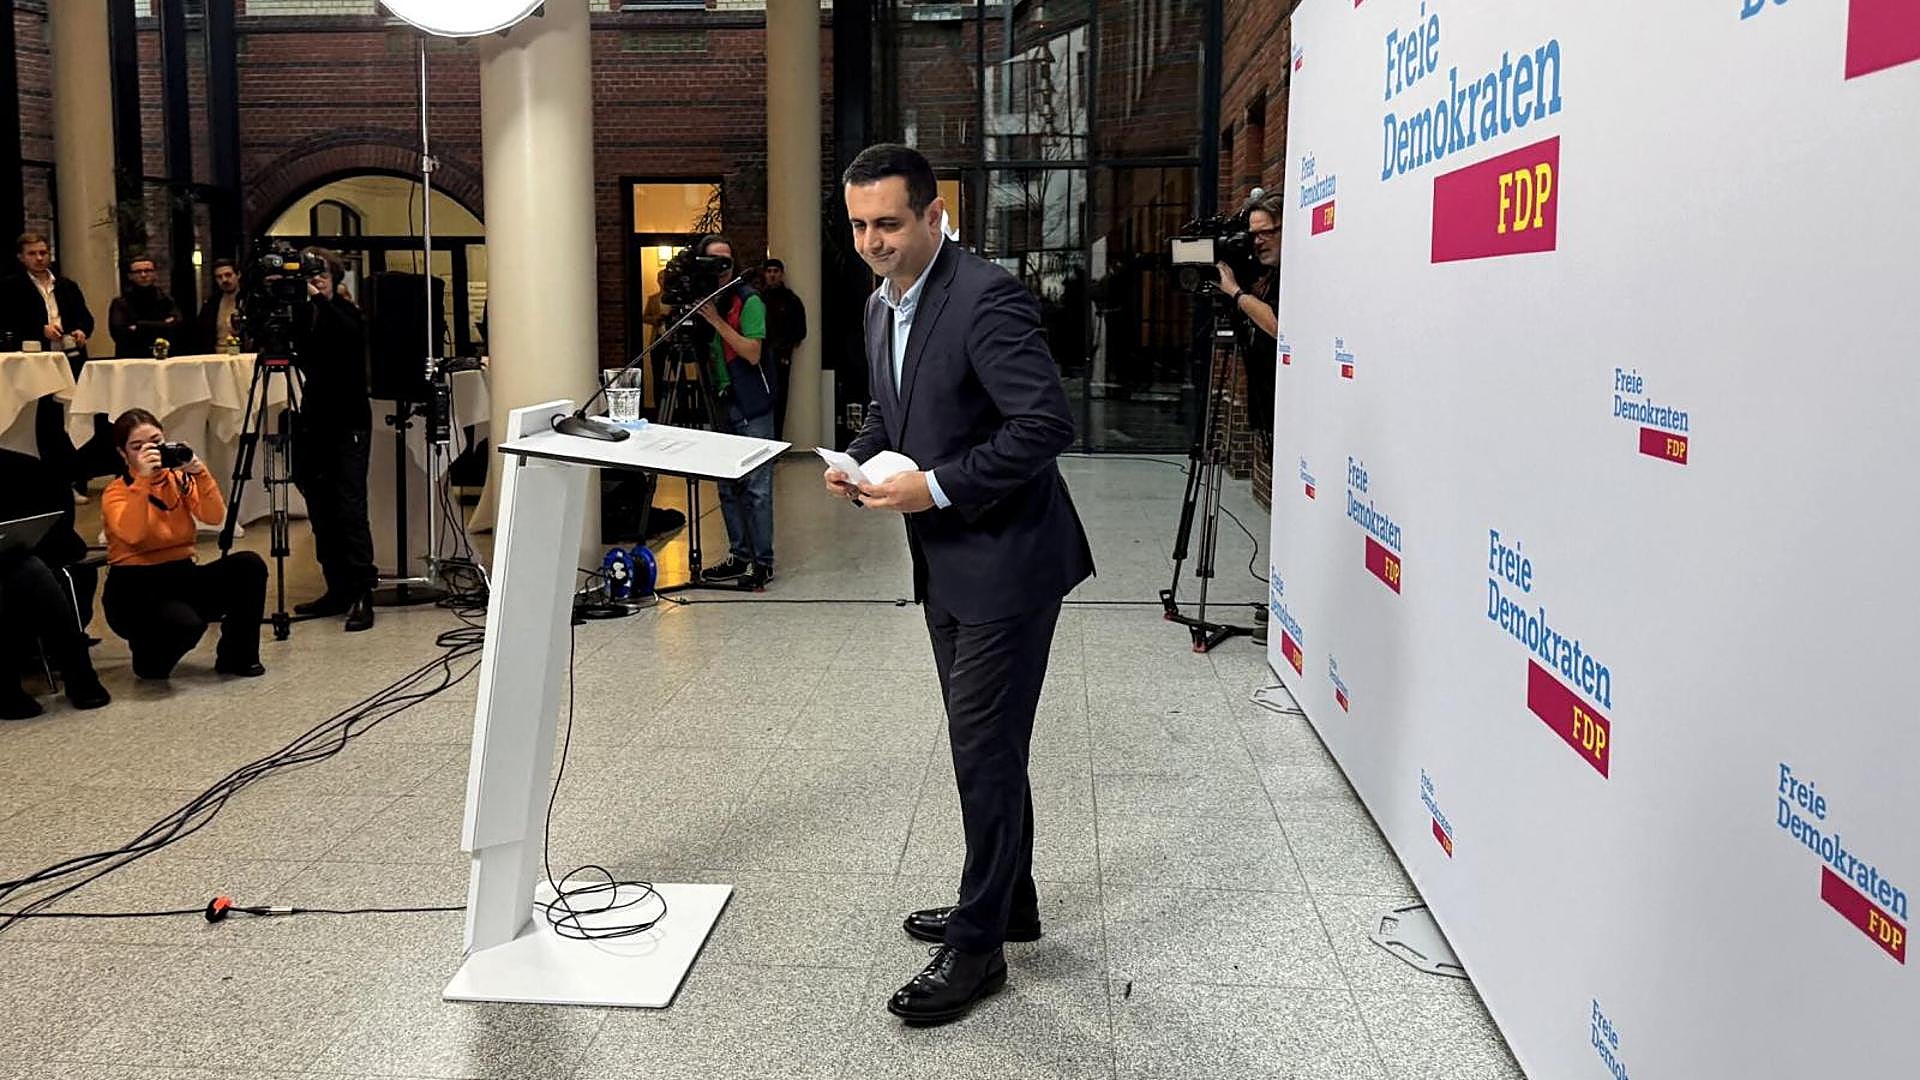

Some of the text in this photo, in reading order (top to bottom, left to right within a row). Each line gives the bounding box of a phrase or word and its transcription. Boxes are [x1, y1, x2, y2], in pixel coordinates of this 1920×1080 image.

[1385, 1, 1440, 100] Freie
[1382, 39, 1562, 181] Demokraten
[1498, 163, 1552, 233] FDP
[1615, 368, 1643, 394] Freie
[1614, 395, 1688, 431] Demokraten
[1348, 456, 1368, 492] Freie
[1667, 438, 1686, 458] FDP
[1347, 489, 1401, 552] Demokraten
[1385, 557, 1400, 584] FDP
[1489, 529, 1532, 593] Freie
[1488, 578, 1611, 710] Demokraten
[1572, 706, 1606, 760] FDP
[1779, 763, 1827, 820] Freie
[1777, 797, 1908, 921] Demokraten
[1868, 909, 1902, 950] FDP
[1592, 999, 1618, 1050] Freie
